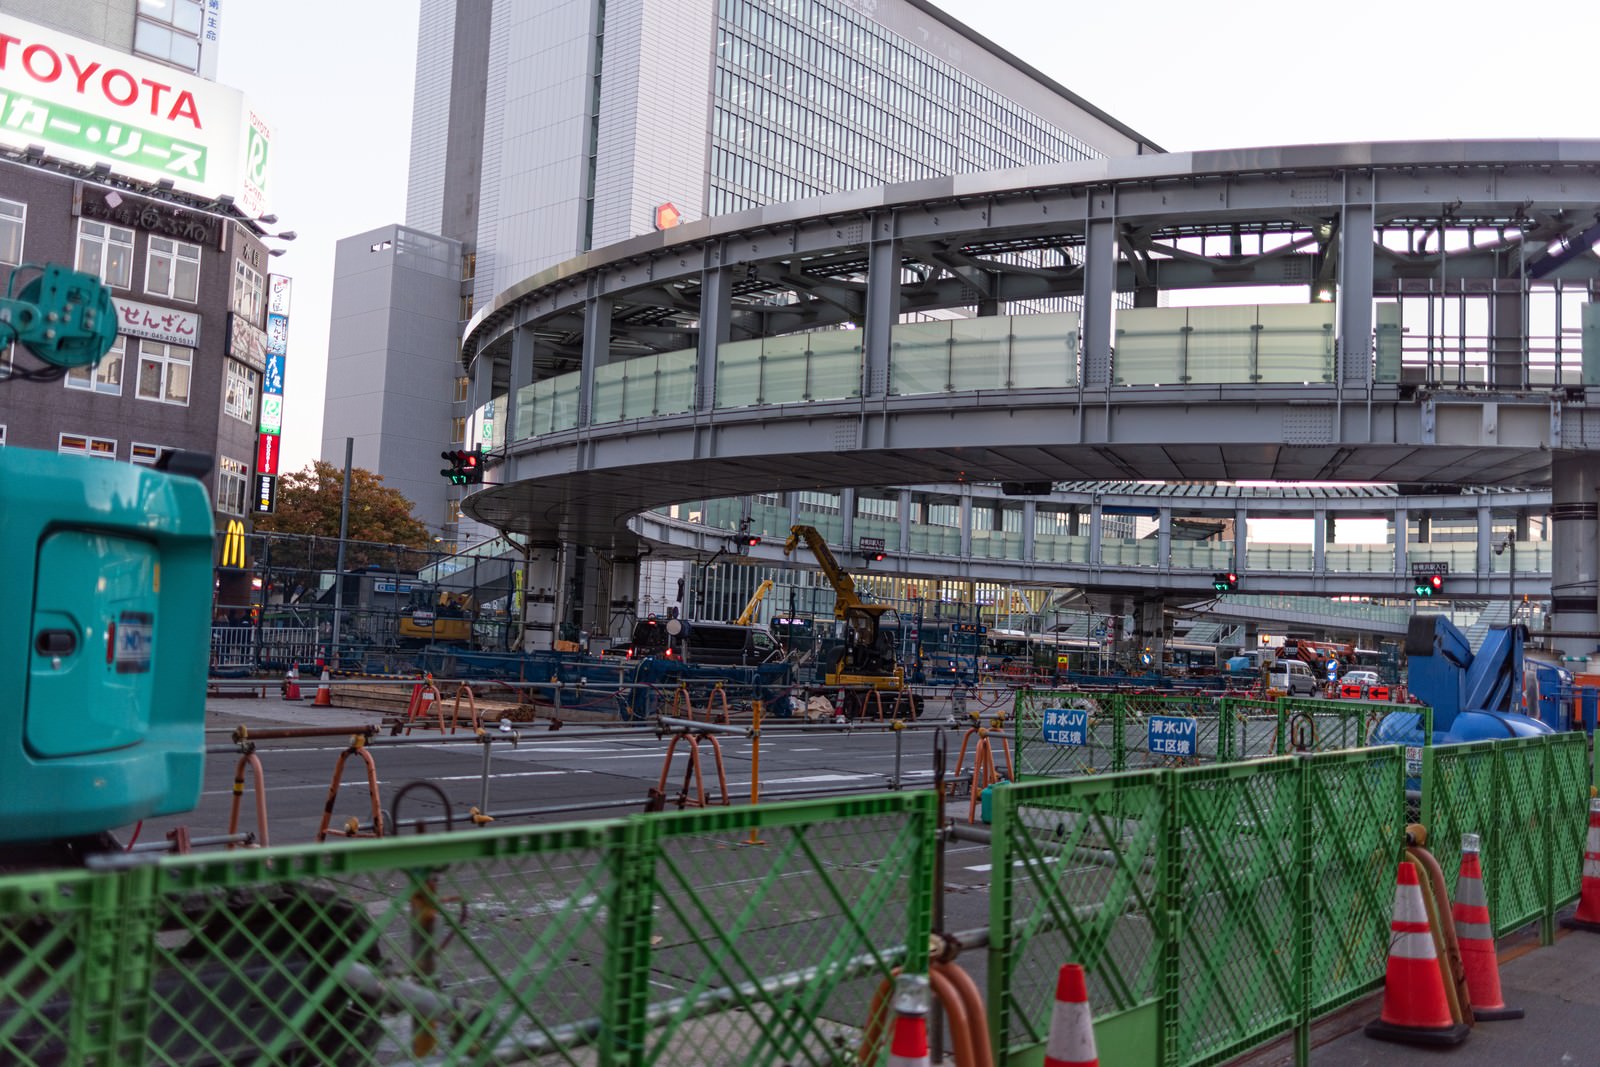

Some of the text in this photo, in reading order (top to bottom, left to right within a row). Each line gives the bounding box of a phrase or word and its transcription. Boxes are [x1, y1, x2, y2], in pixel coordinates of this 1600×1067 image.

[0, 33, 202, 129] TOYOTA
[0, 93, 202, 176] カー・リース
[120, 306, 193, 334] せんざん
[1046, 712, 1084, 727] 清水JV
[1151, 719, 1193, 735] 清水JV
[1047, 730, 1082, 744] 工区境
[1153, 738, 1190, 754] 工区境
